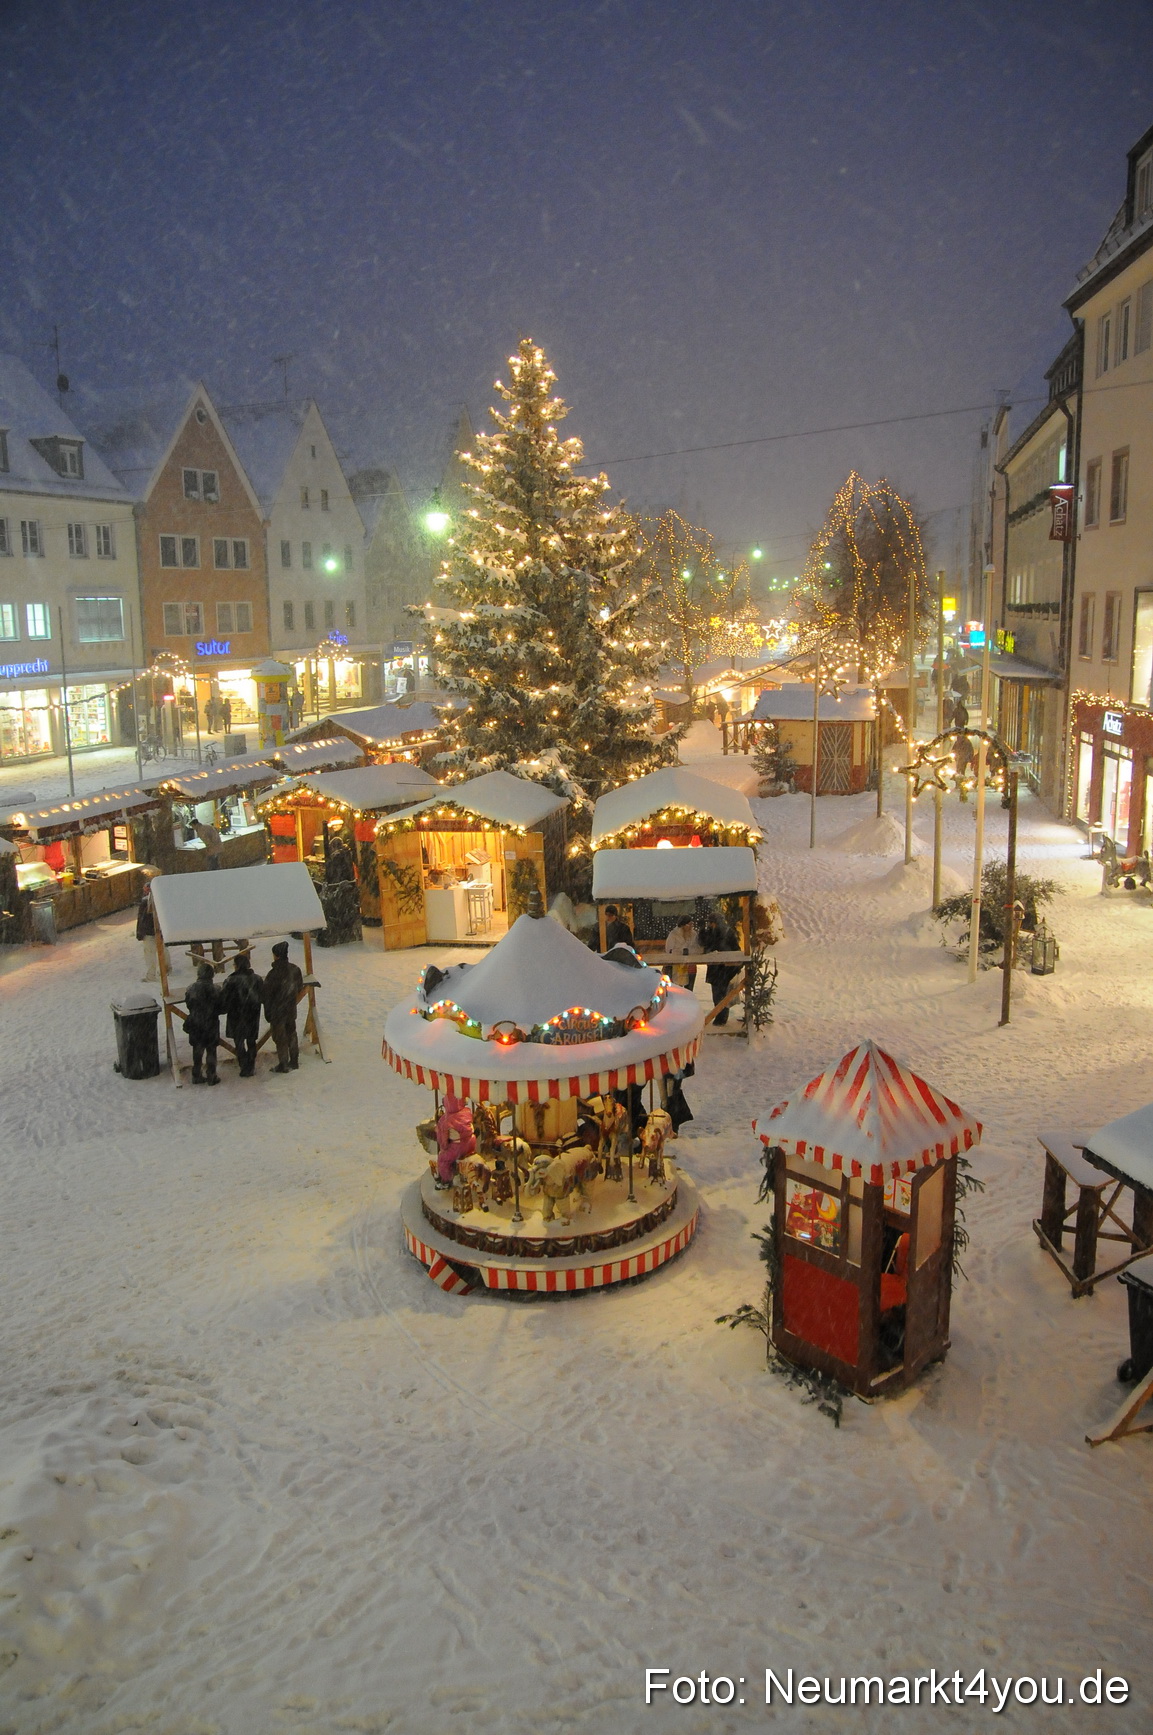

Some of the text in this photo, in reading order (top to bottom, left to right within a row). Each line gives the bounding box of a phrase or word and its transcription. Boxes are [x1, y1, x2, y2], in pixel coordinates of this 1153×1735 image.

[1053, 495, 1068, 536] Achatz
[393, 645, 410, 653] Musik
[558, 1017, 598, 1031] CIRCUS
[540, 1028, 603, 1045] CAROUSEL
